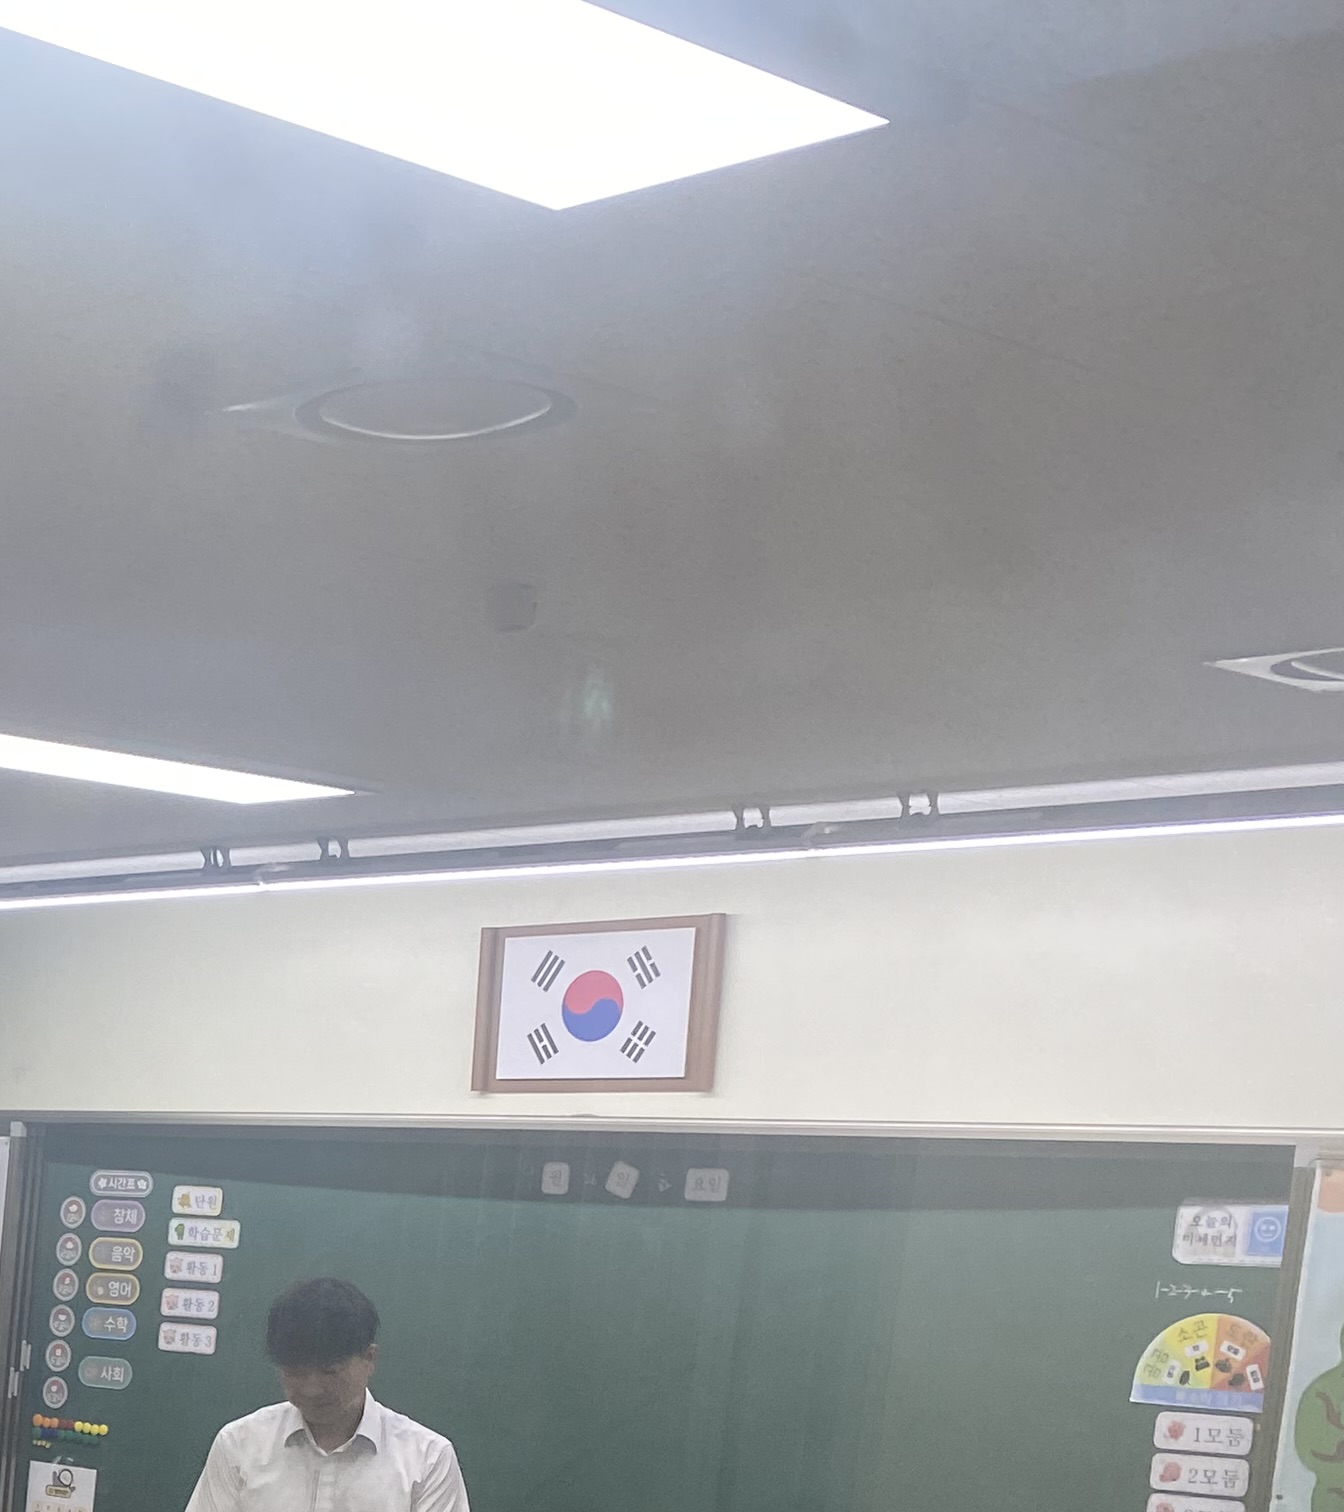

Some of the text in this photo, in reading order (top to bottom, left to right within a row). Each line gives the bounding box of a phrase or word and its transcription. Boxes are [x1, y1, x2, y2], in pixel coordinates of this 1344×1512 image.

[107, 1176, 137, 1190] 시간표
[195, 1194, 218, 1210] 단원
[113, 1208, 138, 1225] 창체
[1189, 1215, 1233, 1229] 오늘의
[188, 1226, 236, 1243] 학습문제
[1182, 1232, 1237, 1247] 미세먼지
[112, 1245, 136, 1262] 음악
[186, 1260, 218, 1276] 활동 1
[108, 1281, 132, 1297] 영어
[182, 1297, 215, 1313] 활동 2
[104, 1316, 129, 1333] 수학
[178, 1332, 212, 1348] 활동 3
[100, 1365, 125, 1383] 사회
